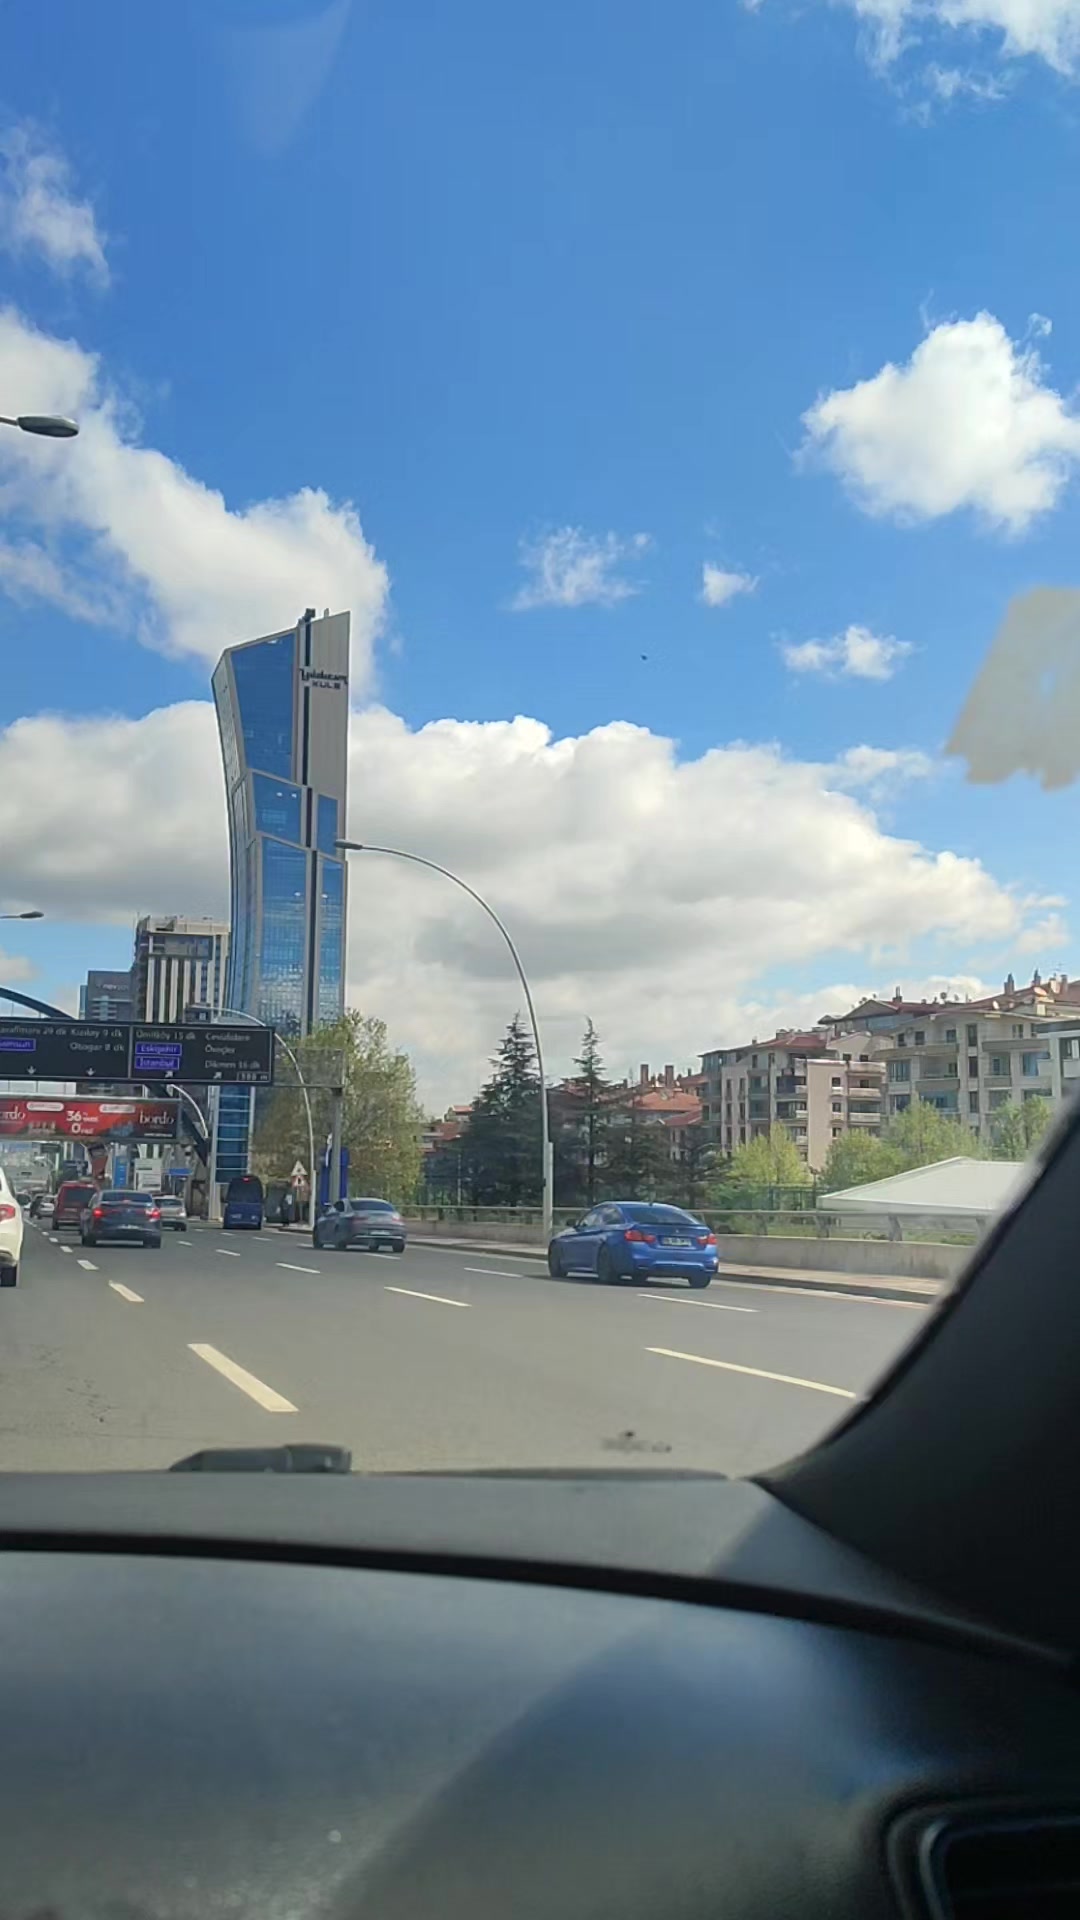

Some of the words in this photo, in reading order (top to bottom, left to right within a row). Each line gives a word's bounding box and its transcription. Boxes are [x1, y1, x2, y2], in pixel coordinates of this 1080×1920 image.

[0, 1105, 26, 1120] ordo
[66, 1110, 82, 1122] 36
[139, 1110, 175, 1125] bordo
